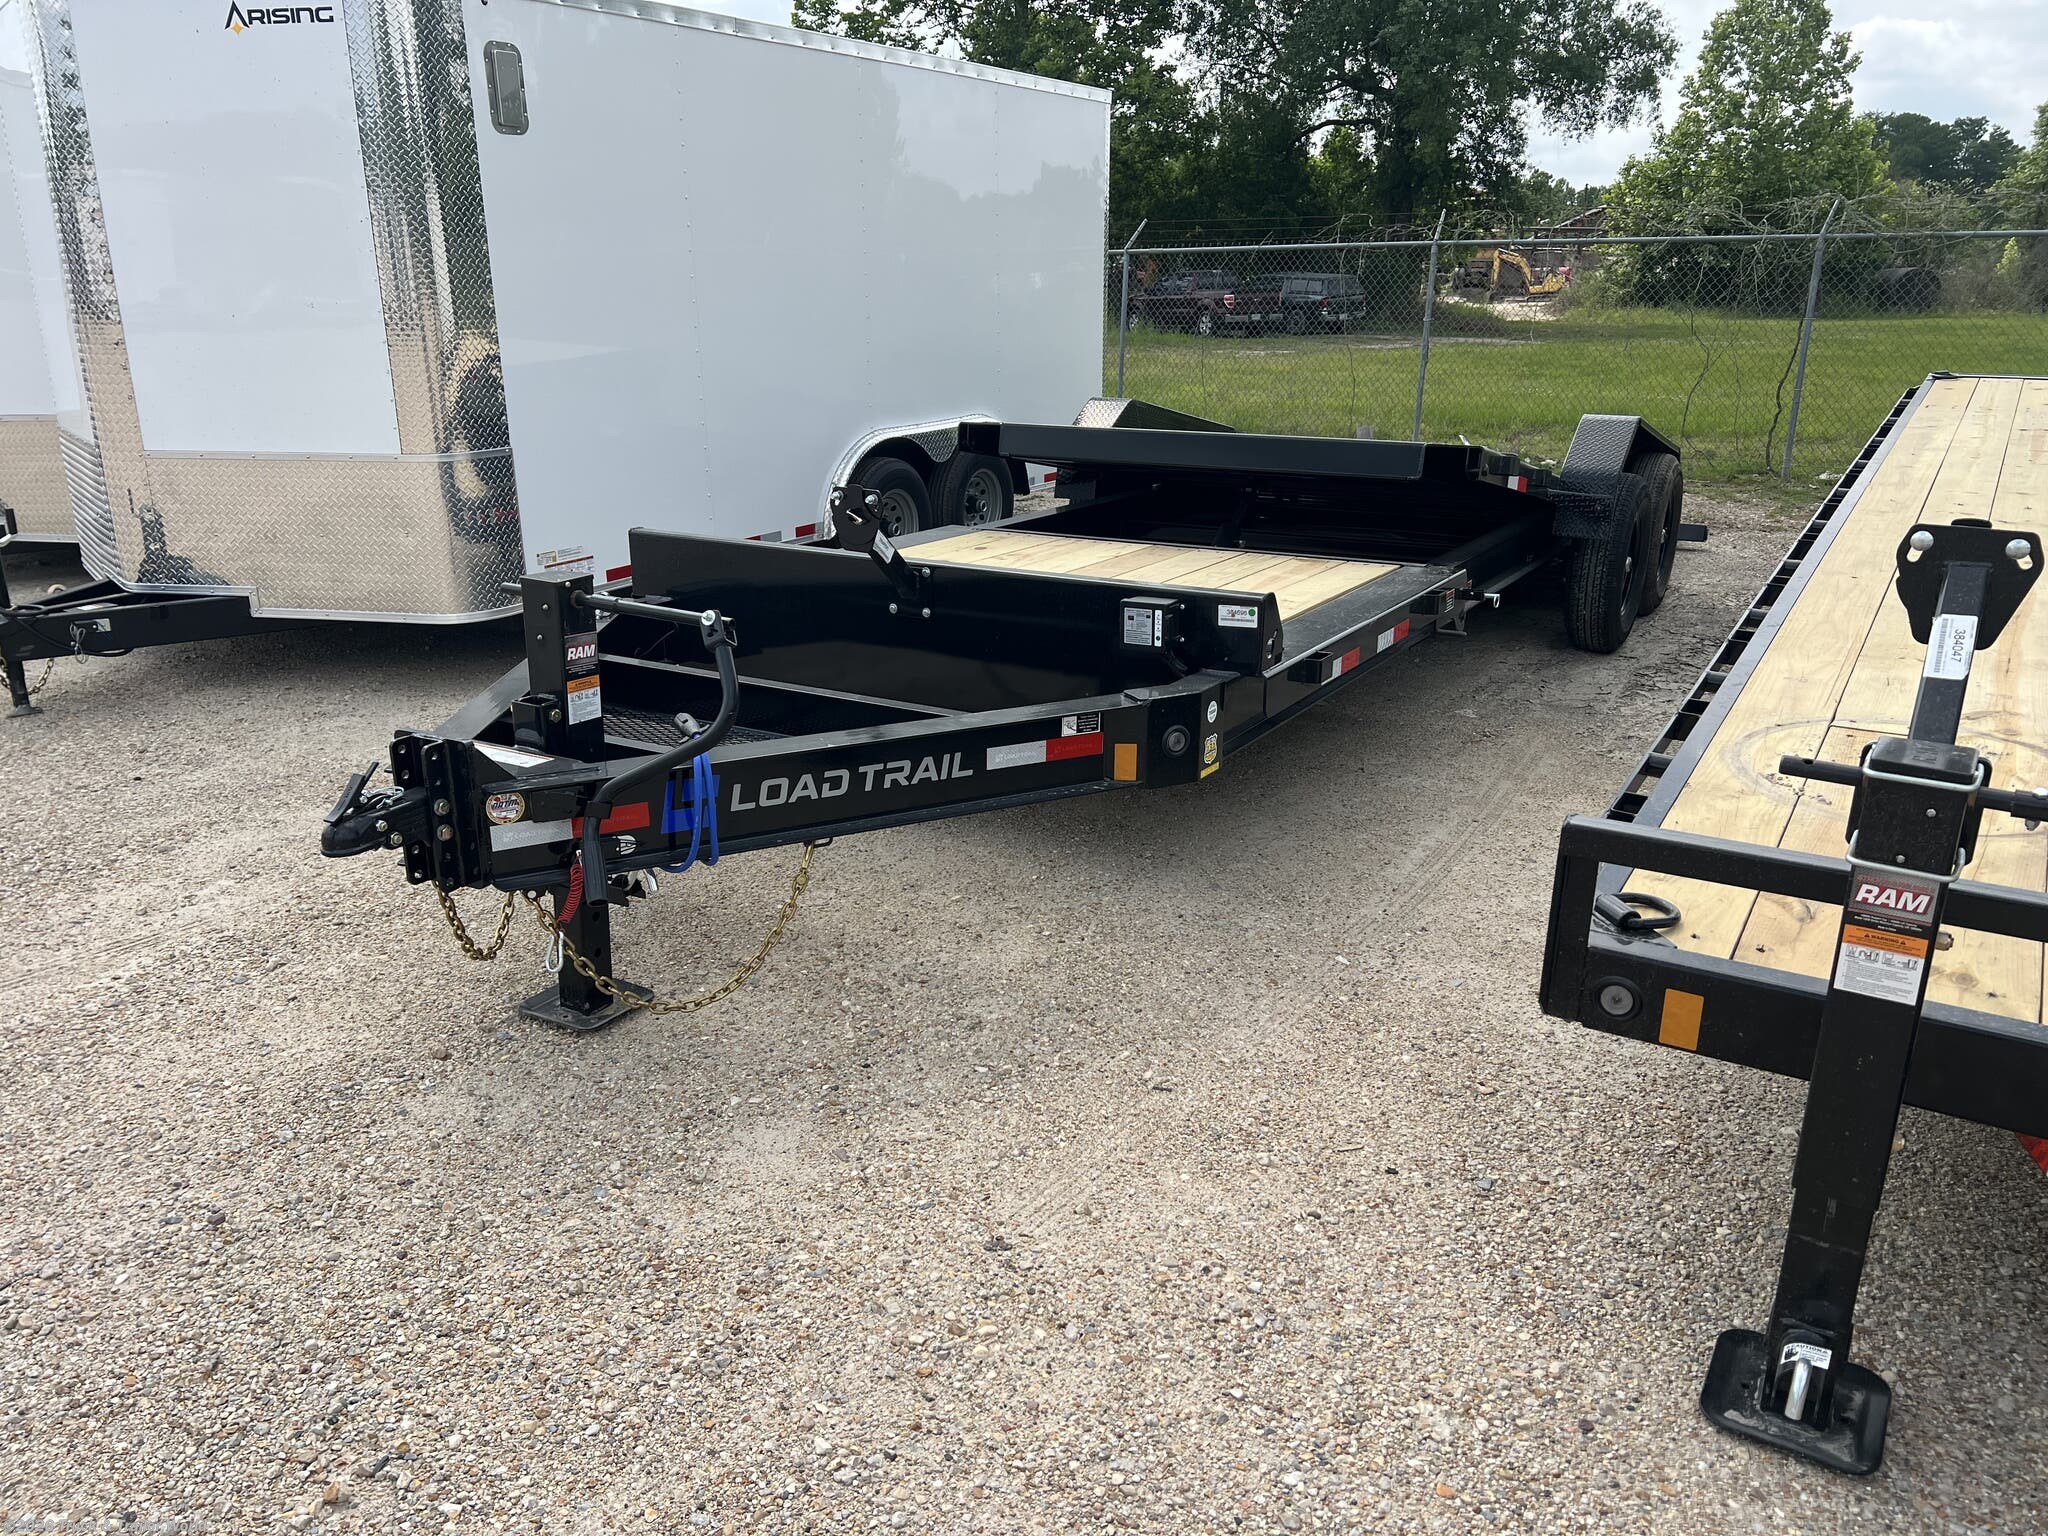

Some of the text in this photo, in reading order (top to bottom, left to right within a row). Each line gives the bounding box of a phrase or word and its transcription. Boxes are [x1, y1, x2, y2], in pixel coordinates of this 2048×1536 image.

[225, 0, 334, 29] ARISING
[567, 644, 596, 661] RAM
[1951, 629, 1966, 663] 384047
[730, 752, 974, 812] LOAD TRAIL
[1855, 883, 1931, 914] RAM
[1871, 934, 1900, 944] WARNING
